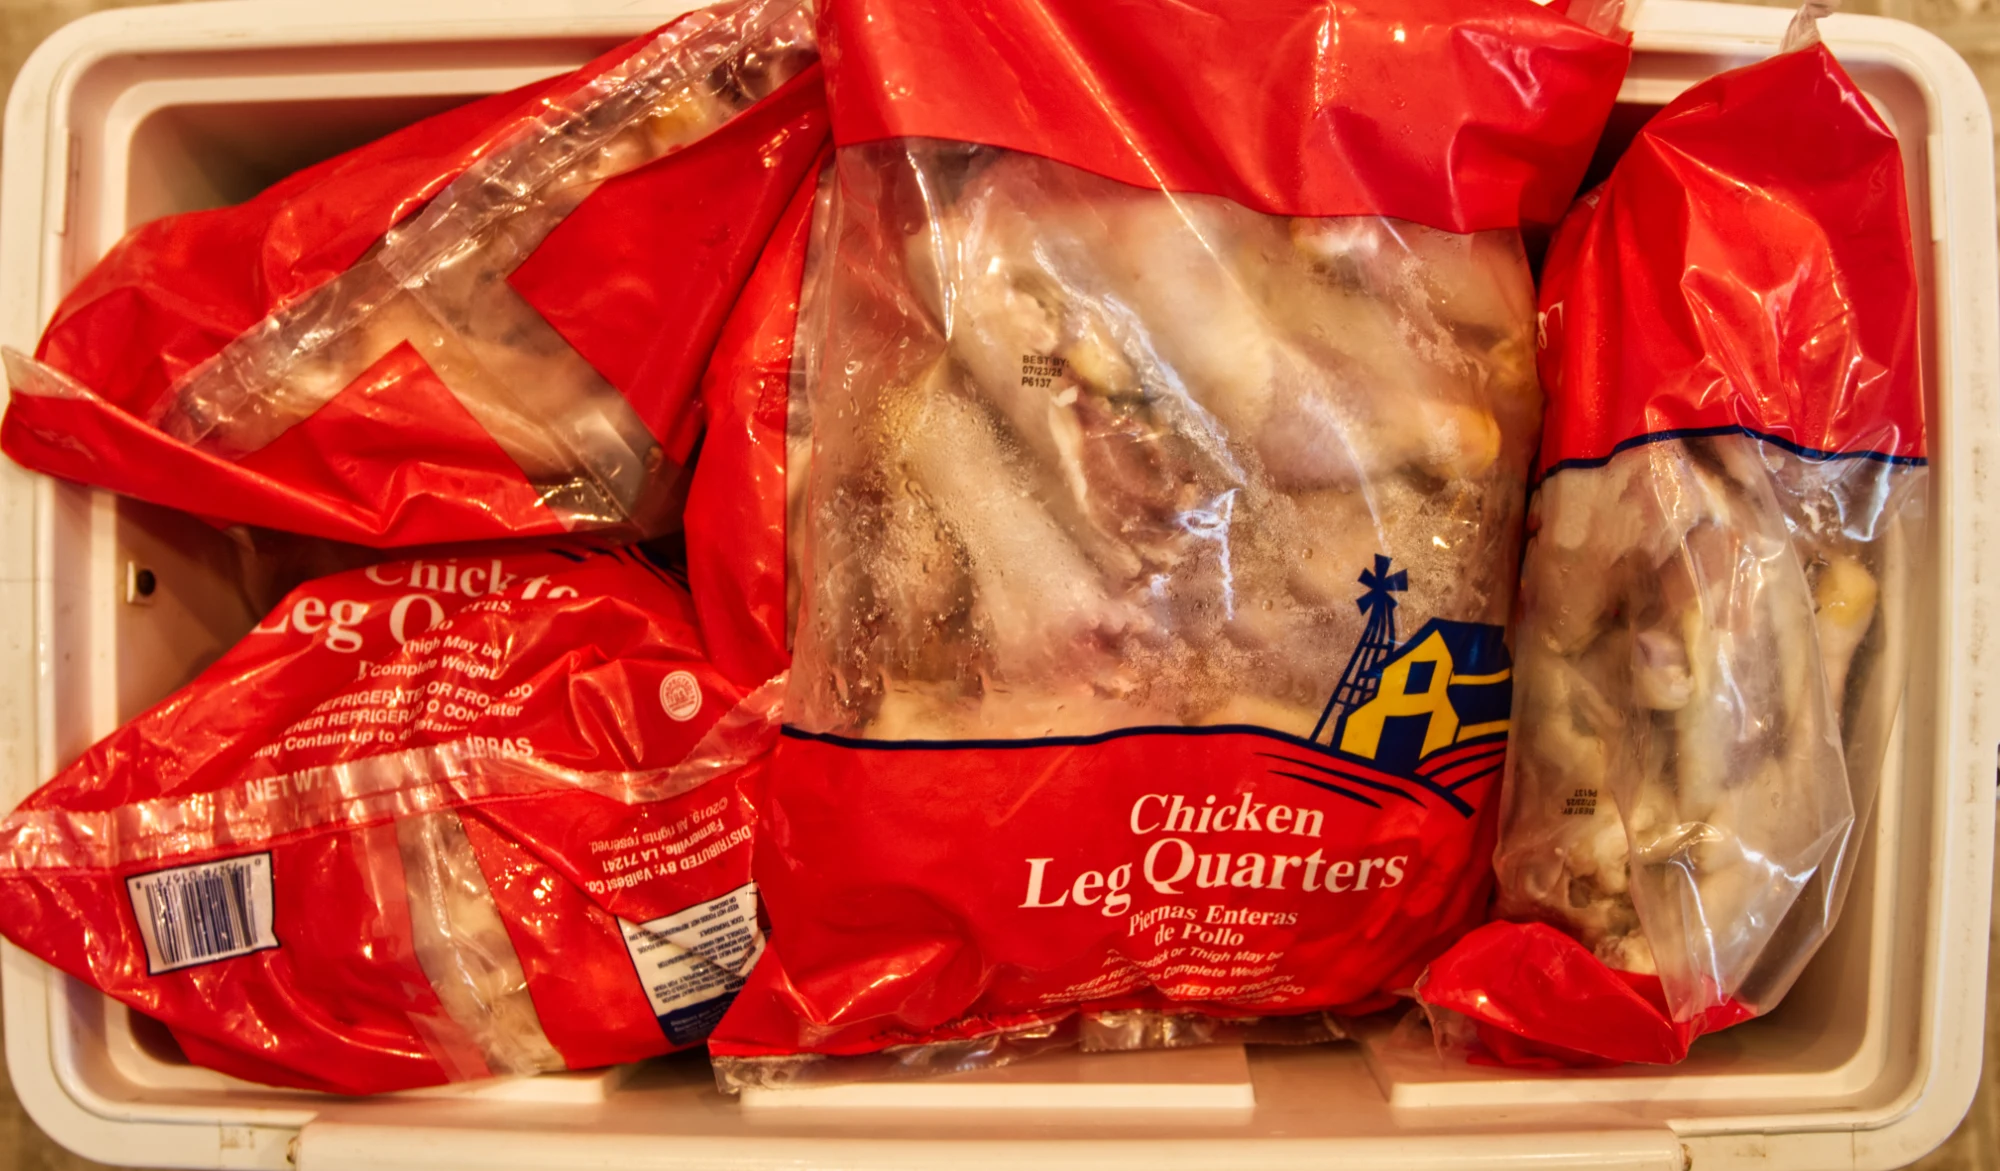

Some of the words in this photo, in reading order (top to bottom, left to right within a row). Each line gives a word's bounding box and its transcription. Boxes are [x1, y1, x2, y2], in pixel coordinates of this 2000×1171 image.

[1022, 355, 1050, 365] BEST
[1021, 377, 1052, 388] P6137
[365, 560, 517, 599] Chick
[250, 595, 369, 653] Leg
[443, 635, 478, 654] May
[481, 644, 503, 660] be
[441, 655, 497, 681] Weight
[427, 681, 453, 697] OR
[455, 687, 490, 708] FRO
[427, 699, 440, 713] O
[285, 734, 346, 751] Contain
[351, 729, 373, 745] up
[379, 729, 395, 743] to
[466, 734, 534, 759] IBRAS
[245, 774, 289, 803] NET
[676, 817, 688, 834] All
[1130, 792, 1325, 838] Chicken
[589, 835, 640, 855] reserved.
[643, 826, 675, 845] rights
[662, 817, 725, 855] Farmerville,
[642, 847, 659, 863] LA
[681, 825, 752, 870] DISTRIBUTED
[602, 853, 639, 873] 71241
[655, 860, 678, 876] BY:
[585, 879, 604, 894] Co.
[608, 868, 653, 889] ValBest
[1018, 857, 1133, 918] Leg
[1143, 837, 1409, 895] Quarters
[1127, 904, 1199, 938] Piernas
[1205, 904, 1299, 926] Enteras
[1154, 924, 1176, 947] de
[1181, 923, 1245, 947] Pollo
[1170, 947, 1187, 958] or
[1190, 946, 1231, 963] Thigh
[1233, 951, 1265, 964] May
[1163, 964, 1227, 979] Complete
[1065, 974, 1107, 992] KEEP
[1213, 986, 1237, 996] OR
